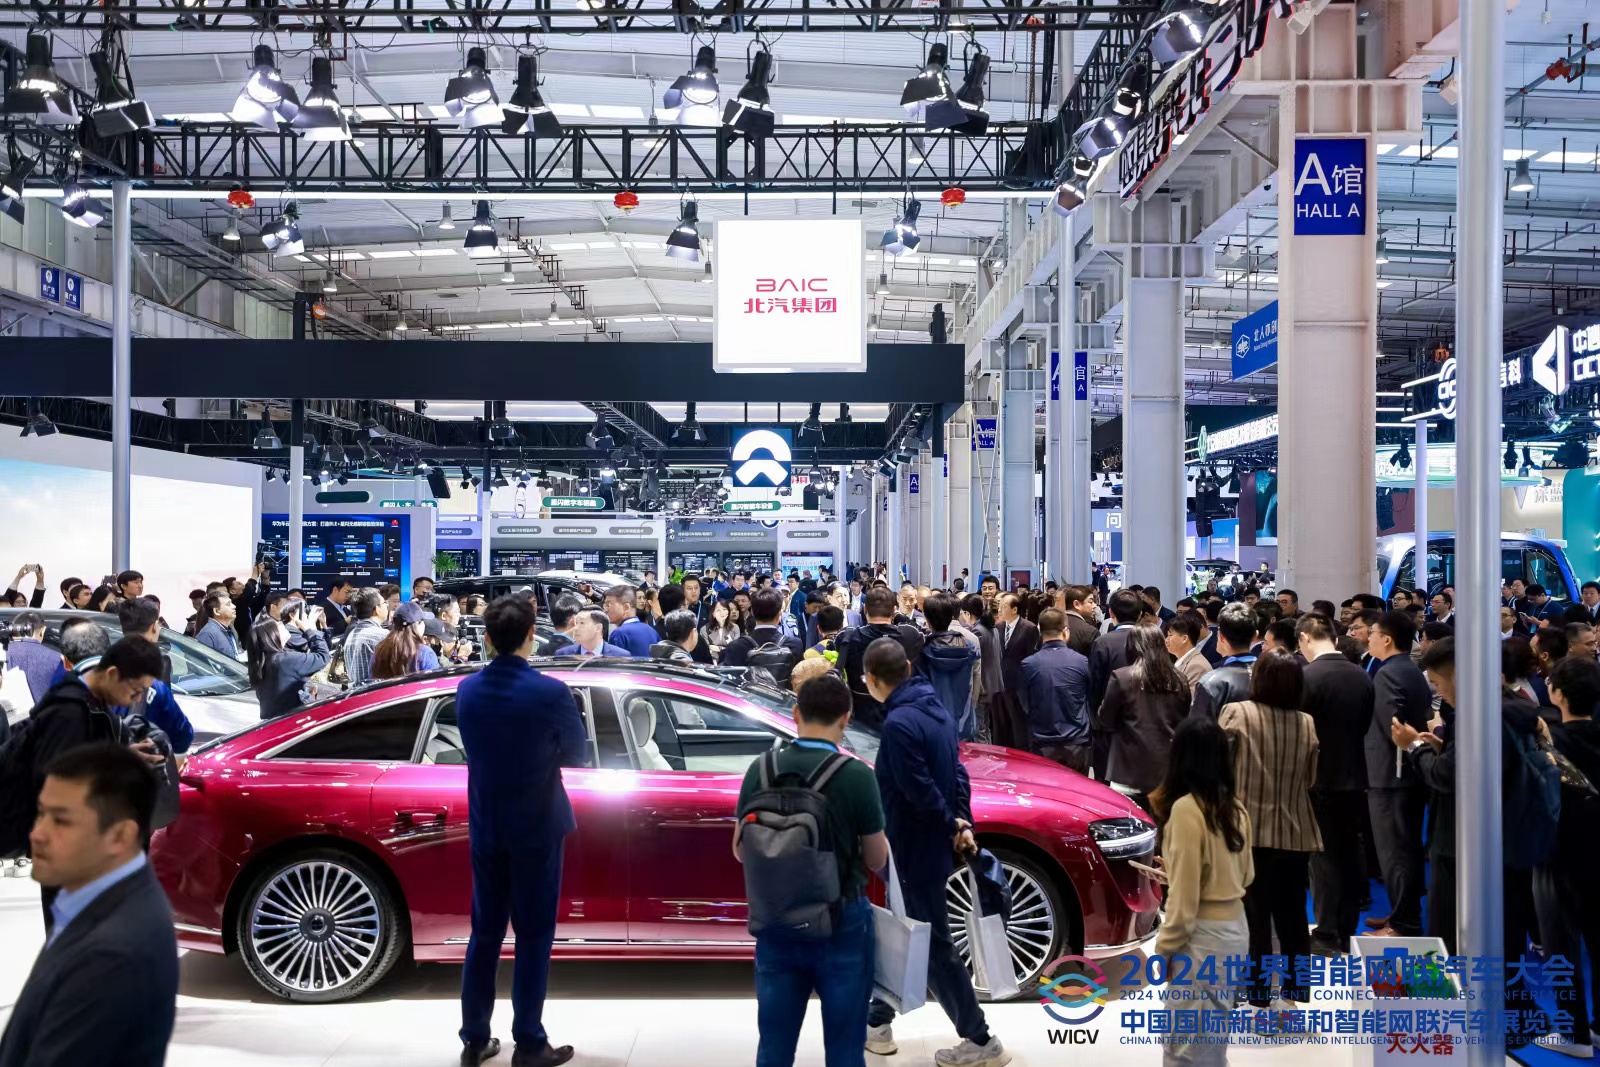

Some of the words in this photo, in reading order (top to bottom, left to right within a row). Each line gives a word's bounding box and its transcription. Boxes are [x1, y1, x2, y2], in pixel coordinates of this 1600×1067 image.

[1294, 152, 1364, 197] A馆
[1296, 203, 1342, 219] HALL
[1347, 203, 1361, 218] A
[756, 278, 828, 292] BAIC
[743, 297, 837, 314] 北汽集团
